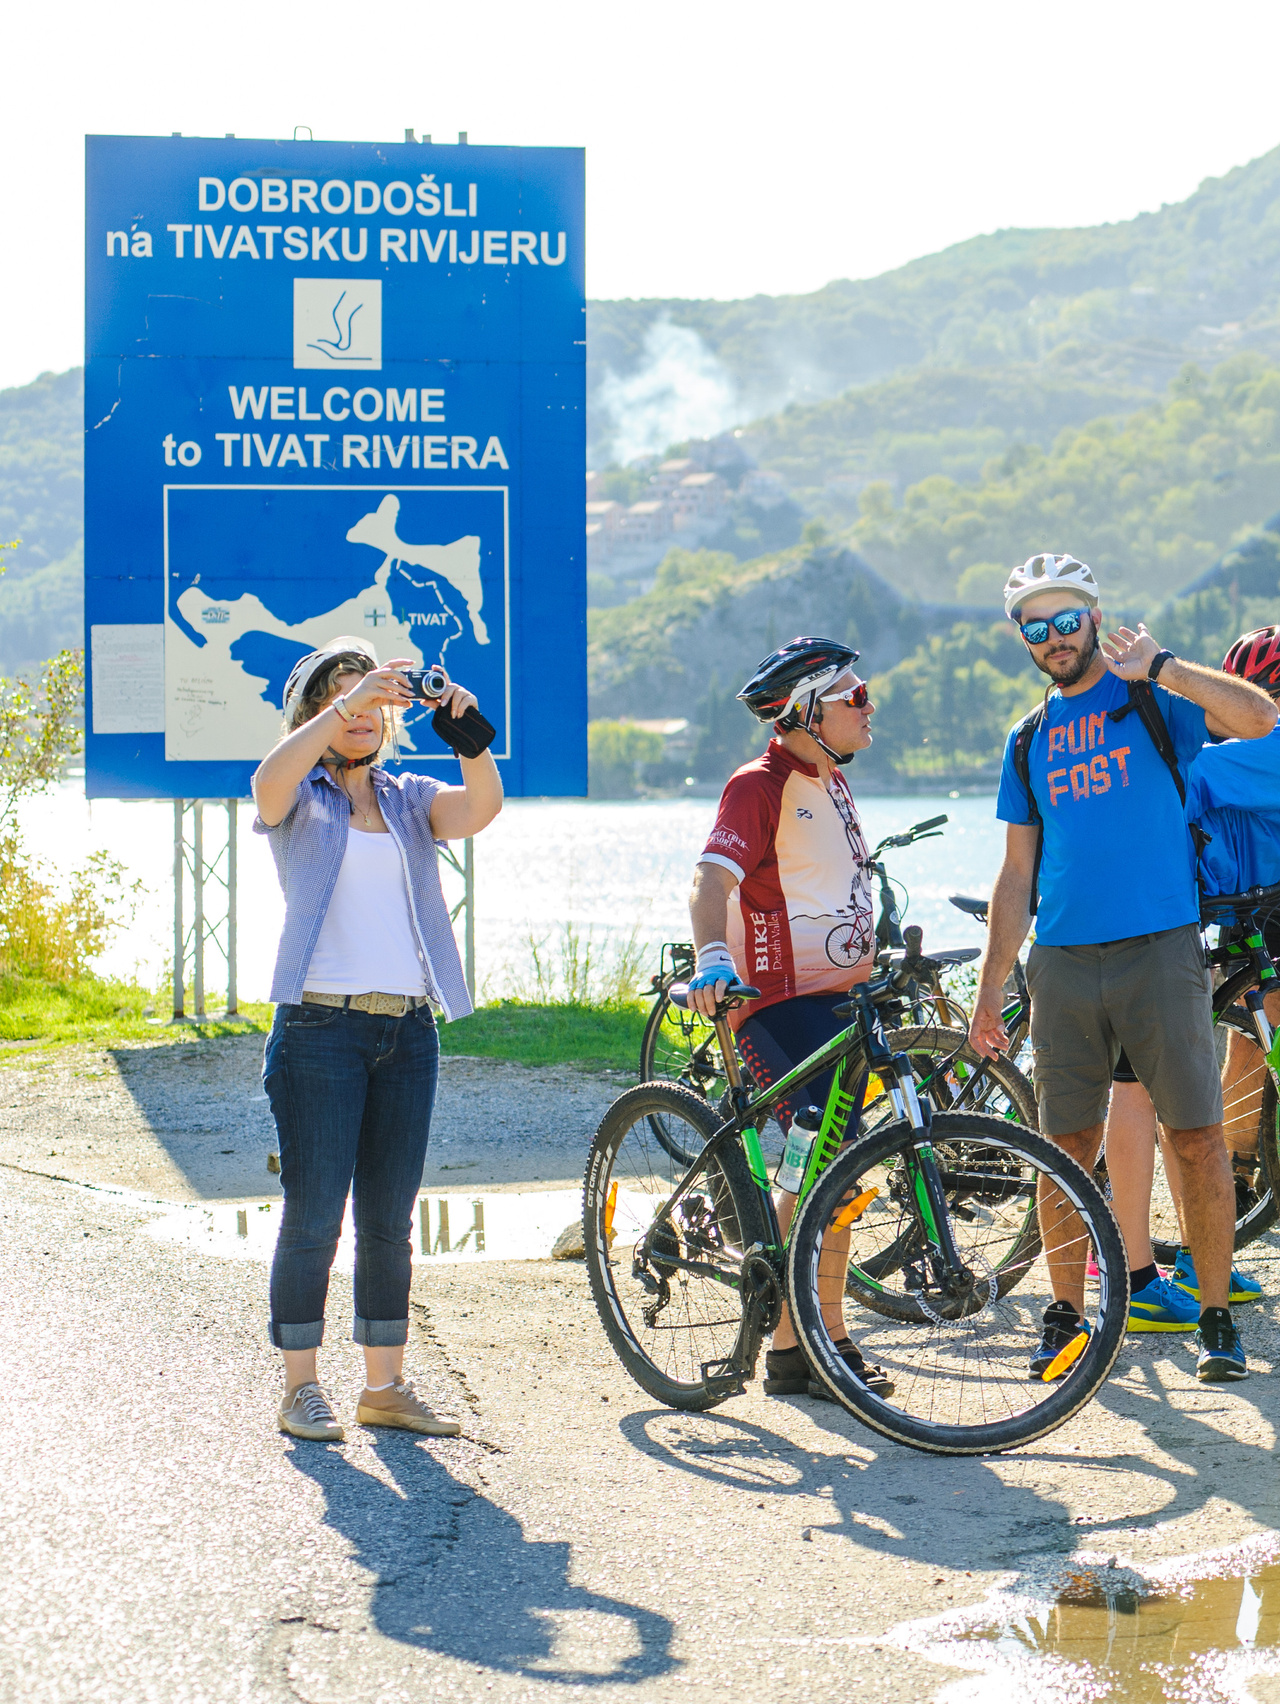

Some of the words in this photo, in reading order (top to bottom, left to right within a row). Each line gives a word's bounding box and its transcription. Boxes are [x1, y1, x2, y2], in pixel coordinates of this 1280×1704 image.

[199, 174, 477, 217] DOBRODOŠLI
[167, 223, 368, 262] TIVATSKU
[380, 229, 566, 266] RIVIJERU
[229, 386, 445, 422] WELCOME
[162, 434, 202, 467] to
[215, 434, 330, 468] TIVAT
[342, 435, 509, 470] RIVIERA
[408, 613, 448, 626] TIVAT
[1047, 710, 1108, 762] RUN
[1047, 746, 1131, 808] FAST
[749, 911, 769, 973] BIKE
[767, 910, 783, 939] Valley
[768, 939, 783, 971] Death
[588, 1150, 602, 1189] CRITTER
[811, 1327, 836, 1370] Rubena
